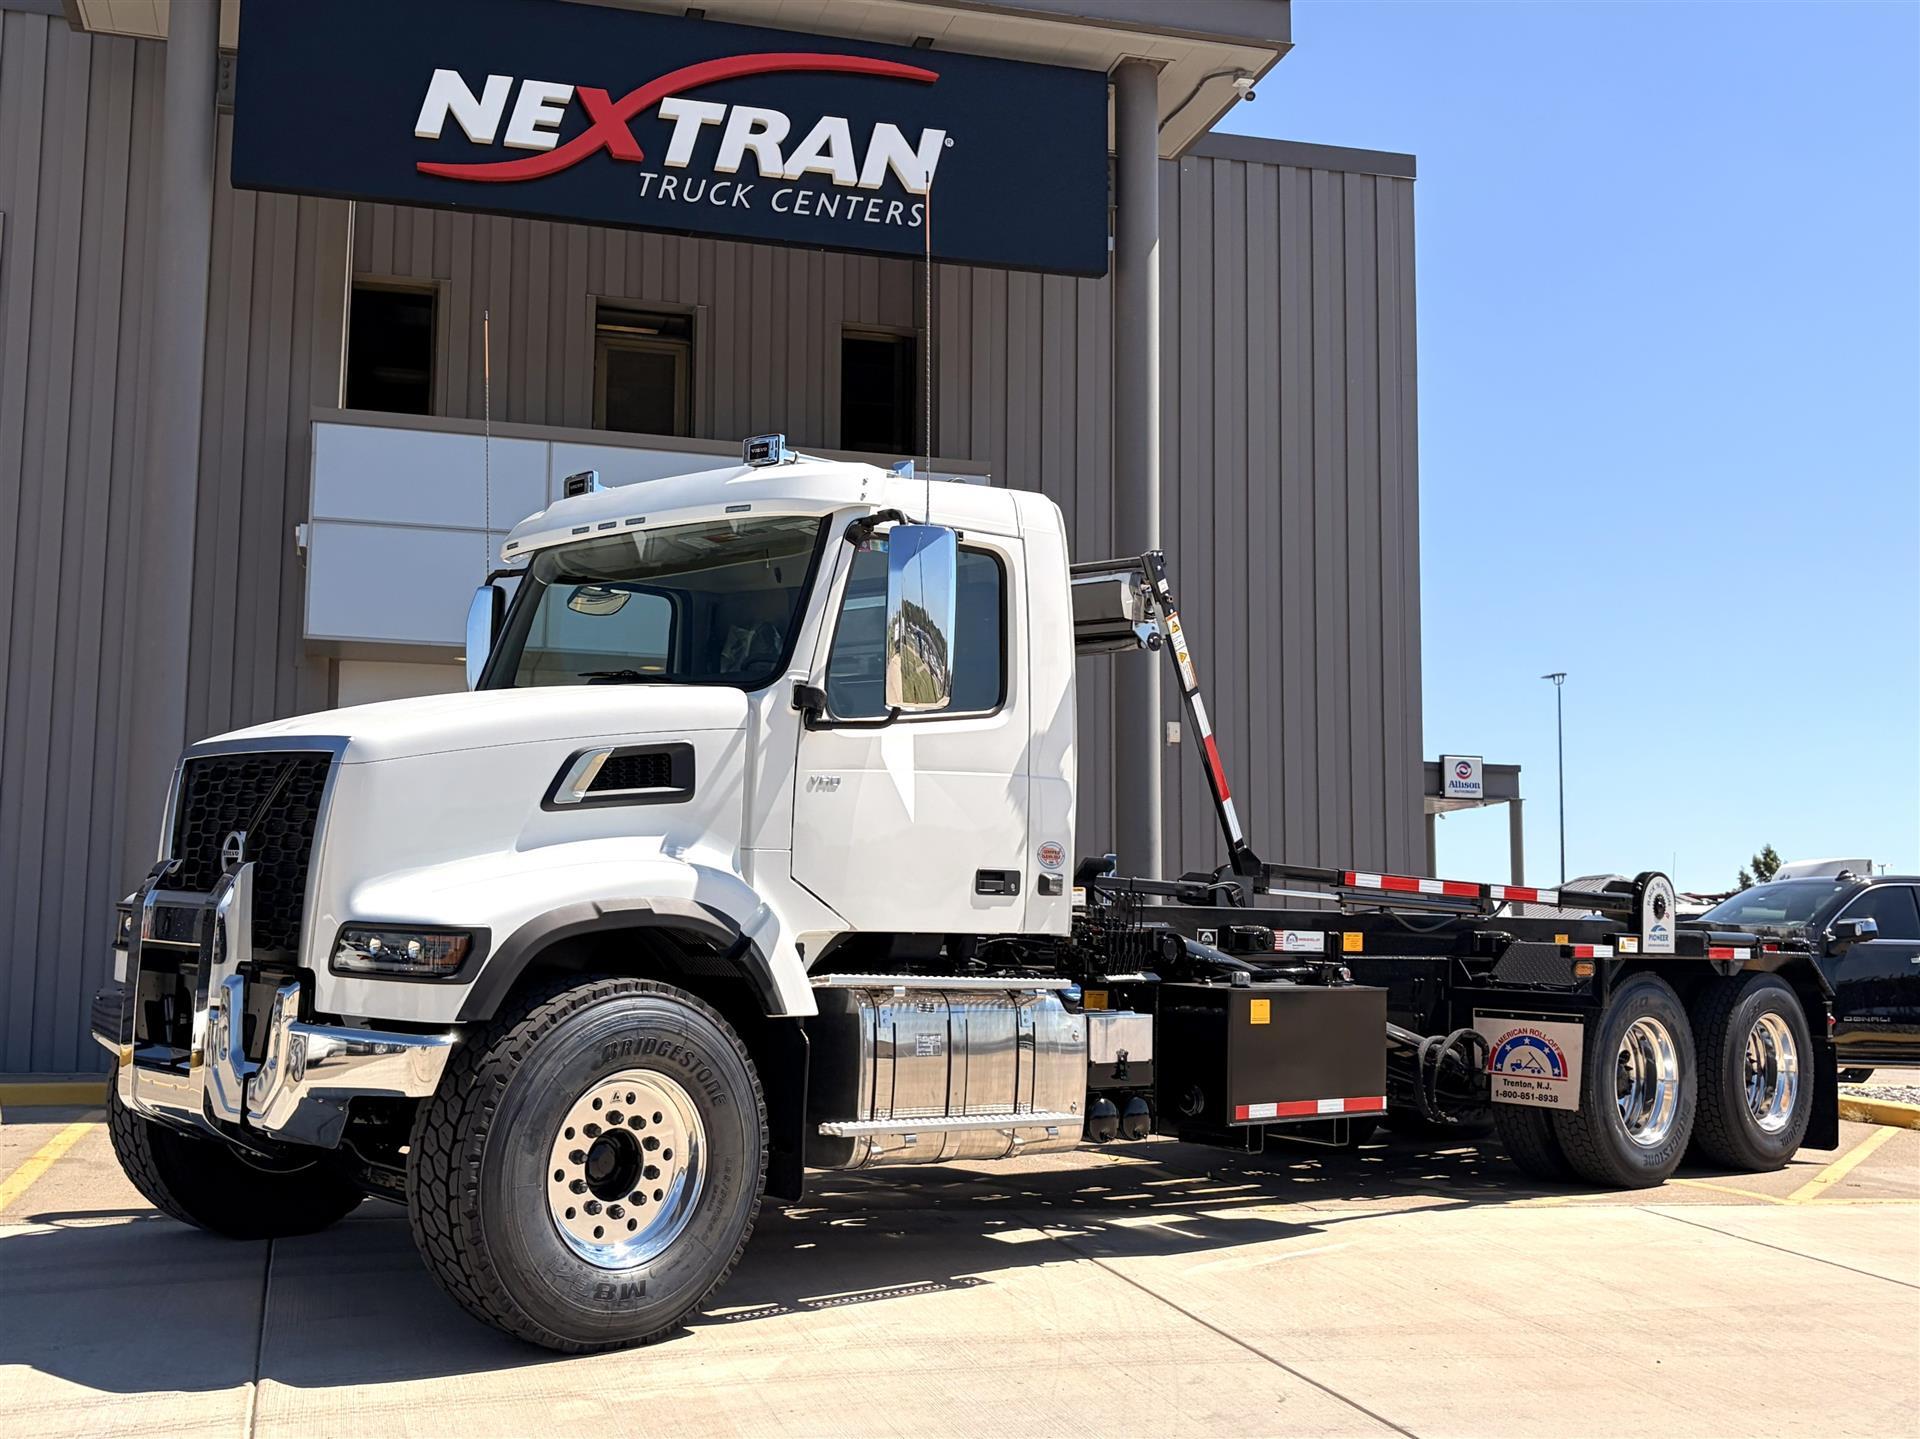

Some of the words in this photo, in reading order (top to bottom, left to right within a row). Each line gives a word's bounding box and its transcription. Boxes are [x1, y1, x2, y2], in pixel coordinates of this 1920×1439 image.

[415, 68, 946, 194] NEXTRAN
[639, 172, 754, 209] TRUCK
[771, 188, 924, 227] CENTERS
[1448, 780, 1481, 790] Allison
[1494, 1027, 1529, 1049] AMERICAN
[1528, 1028, 1561, 1053] ROLL-OFF
[601, 1036, 727, 1107] BRIDGESTONE
[1503, 1078, 1535, 1091] Trenton,
[1536, 1081, 1552, 1091] N.J.
